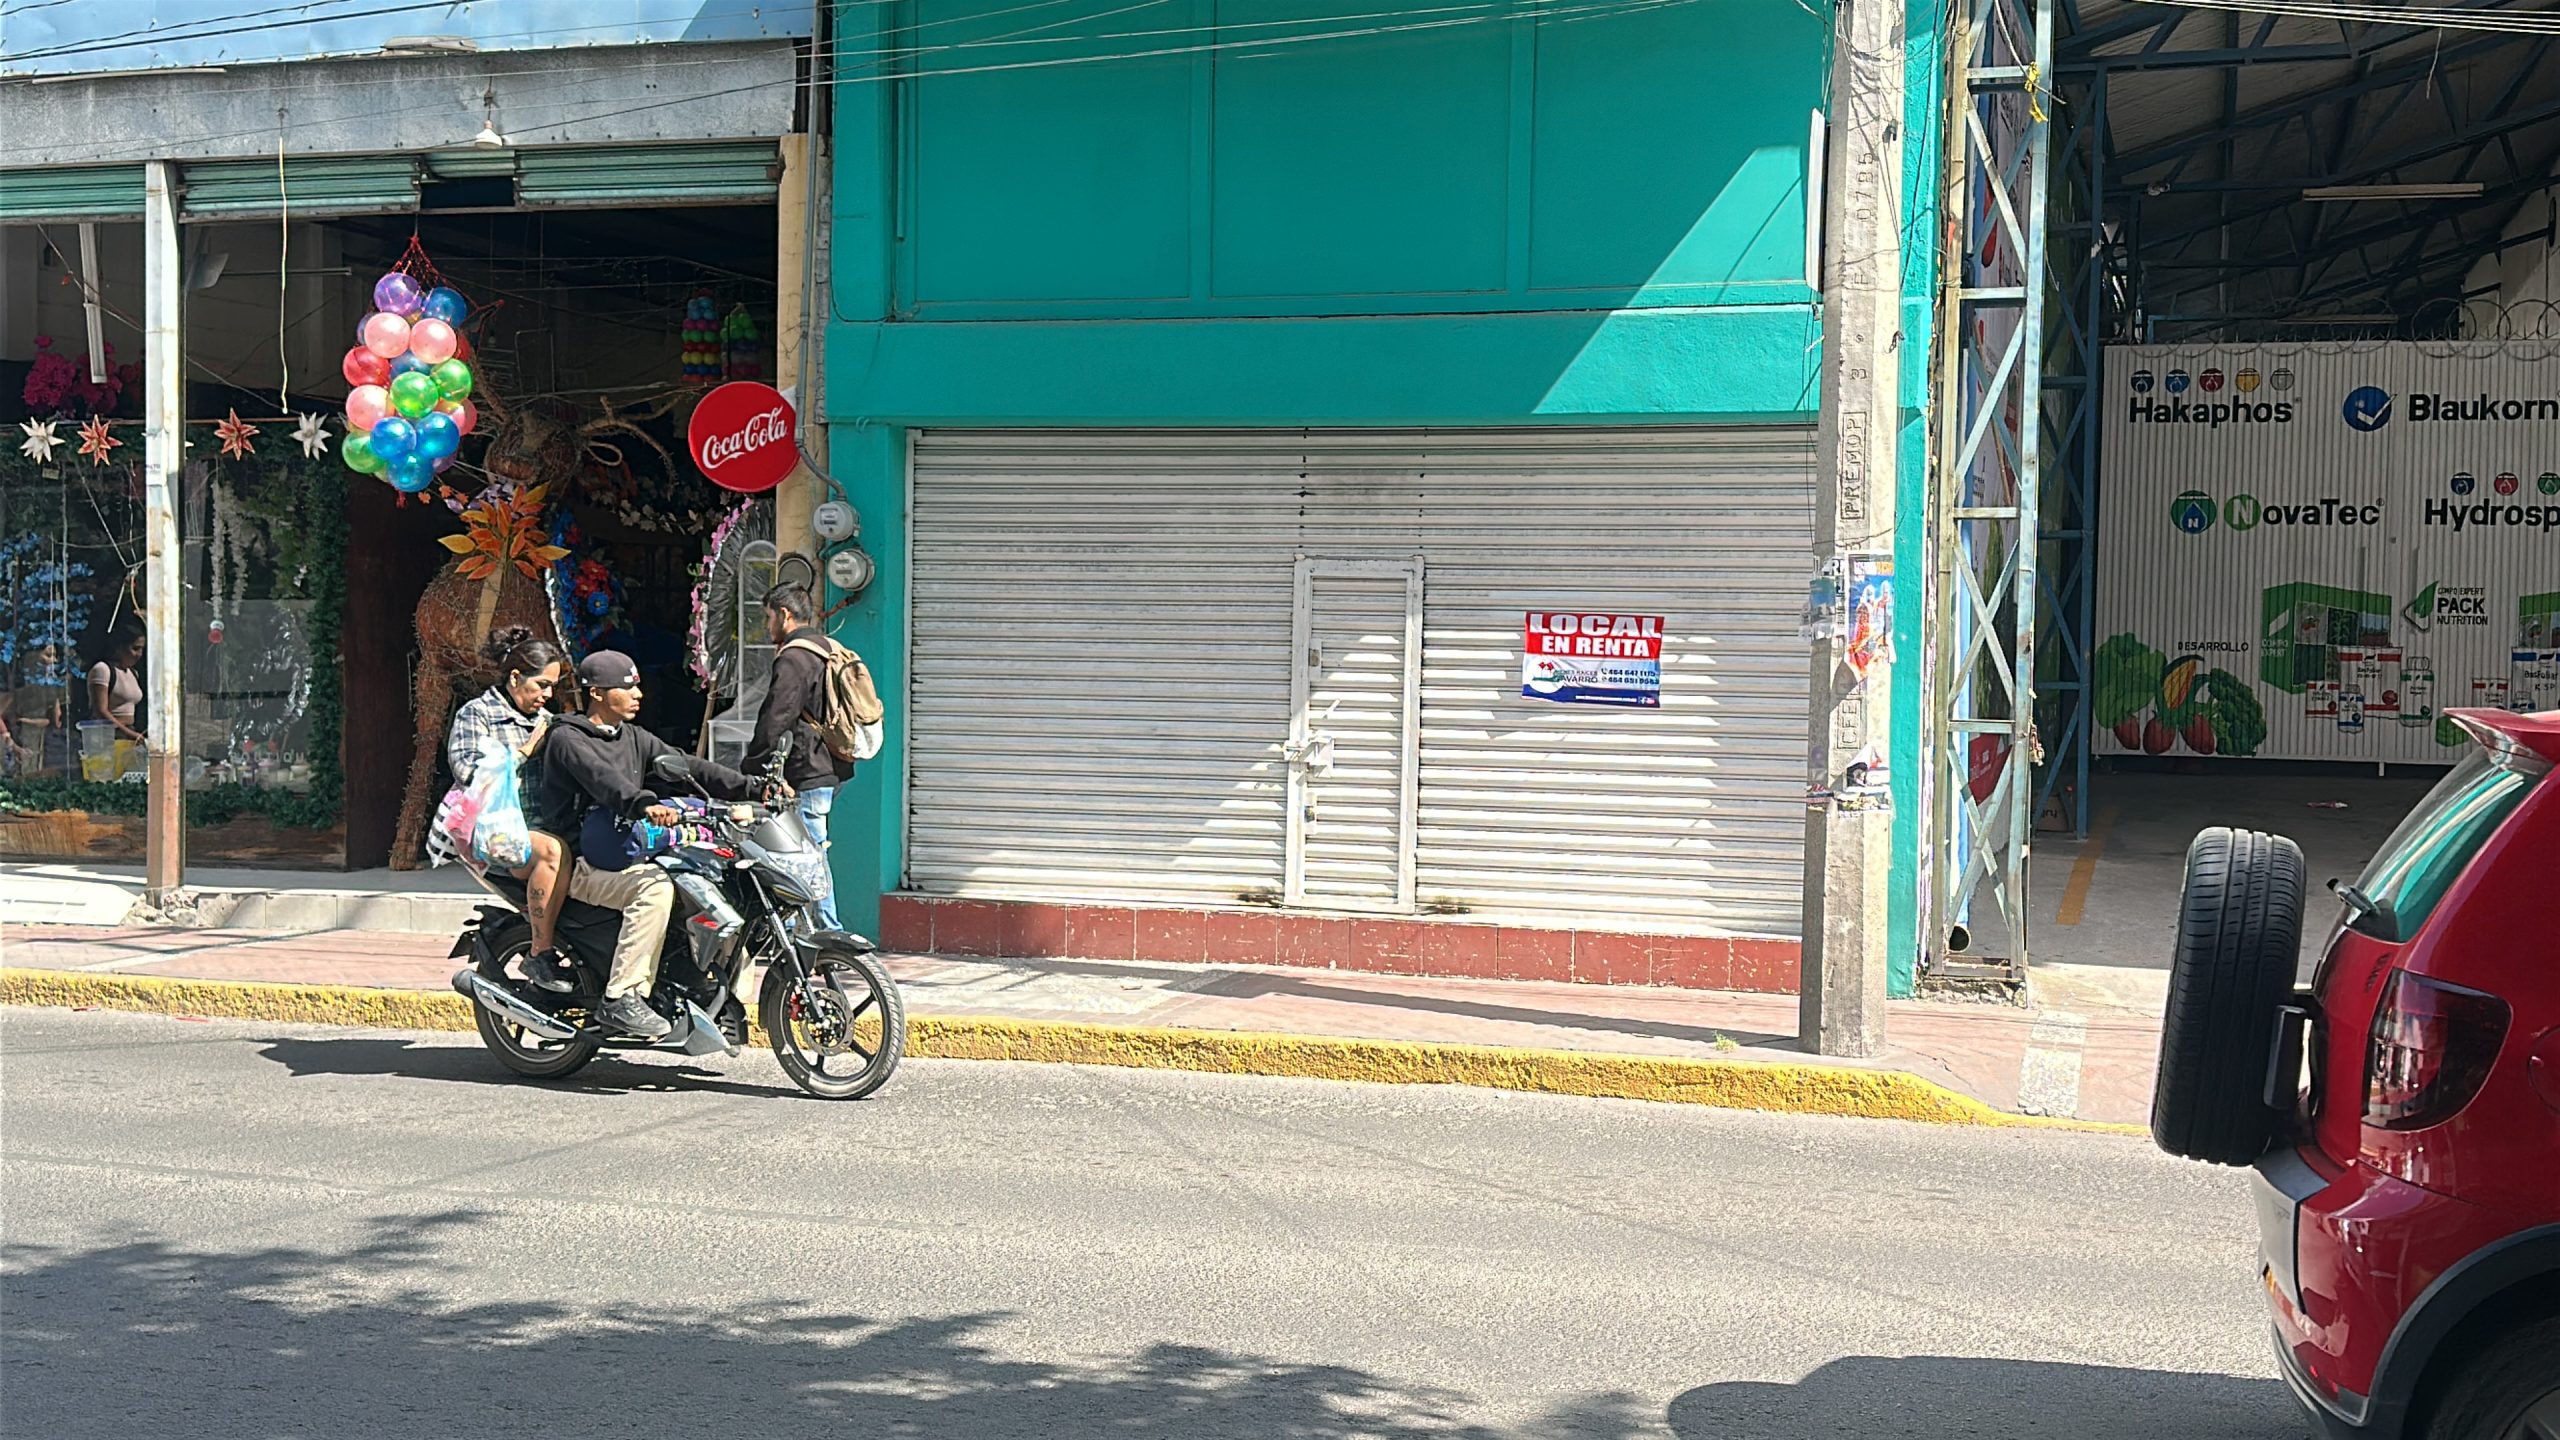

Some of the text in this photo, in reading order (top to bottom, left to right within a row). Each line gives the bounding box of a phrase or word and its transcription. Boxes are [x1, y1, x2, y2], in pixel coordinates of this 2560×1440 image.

[2129, 395, 2293, 428] Hakaphos
[2409, 393, 2559, 421] Blaukorn
[702, 405, 787, 469] Coca-Cola
[1844, 416, 1863, 515] PREMOP
[2232, 498, 2380, 525] NovaTec
[2425, 498, 2560, 532] Hydrosp
[2437, 597, 2485, 614] PACK
[1529, 613, 1662, 639] LOCAL
[2437, 615, 2488, 625] NUTRITION
[1542, 635, 1650, 657] EN RENTA
[2177, 641, 2249, 652] DESARROLLO
[230, 752, 307, 764] BOUTIQU
